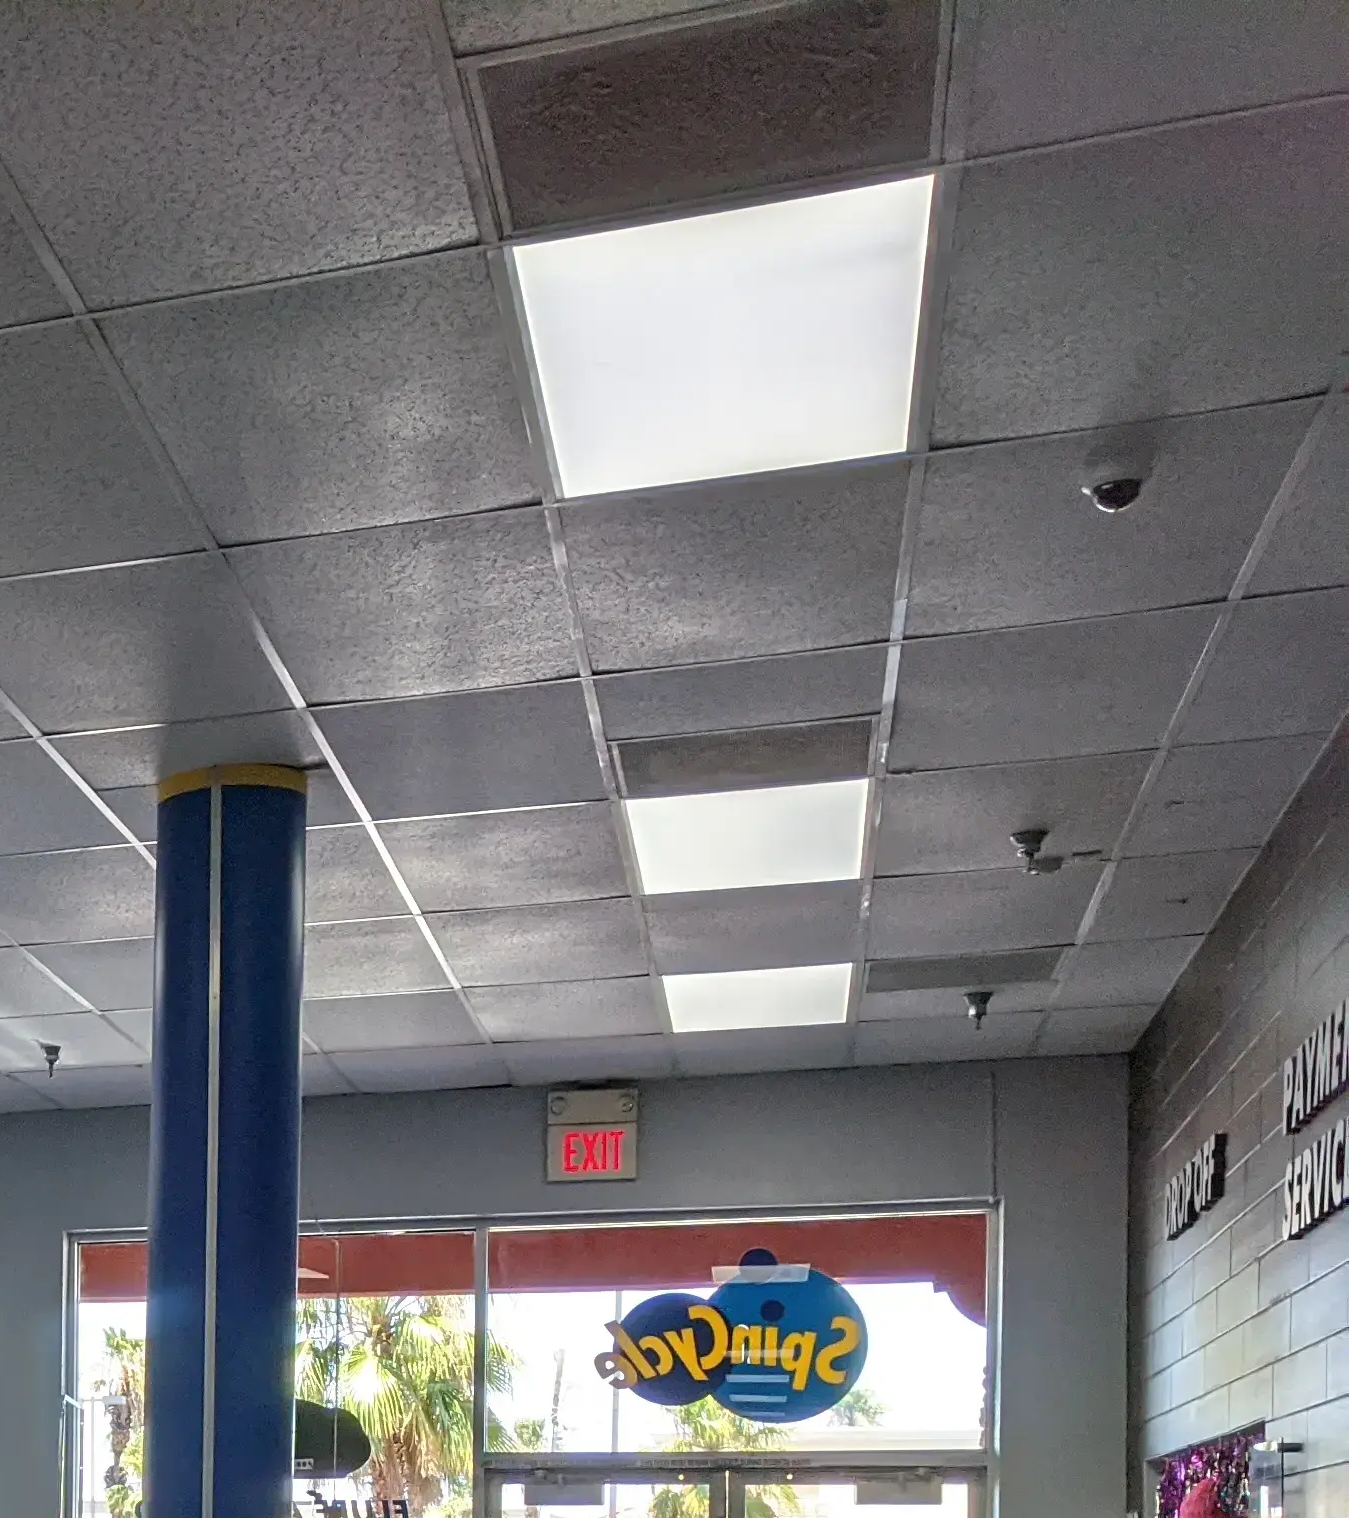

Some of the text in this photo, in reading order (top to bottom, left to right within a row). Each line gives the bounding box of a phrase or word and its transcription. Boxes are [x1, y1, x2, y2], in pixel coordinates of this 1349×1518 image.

[564, 1131, 624, 1172] EXIT
[1164, 1133, 1217, 1241] DROP OFF
